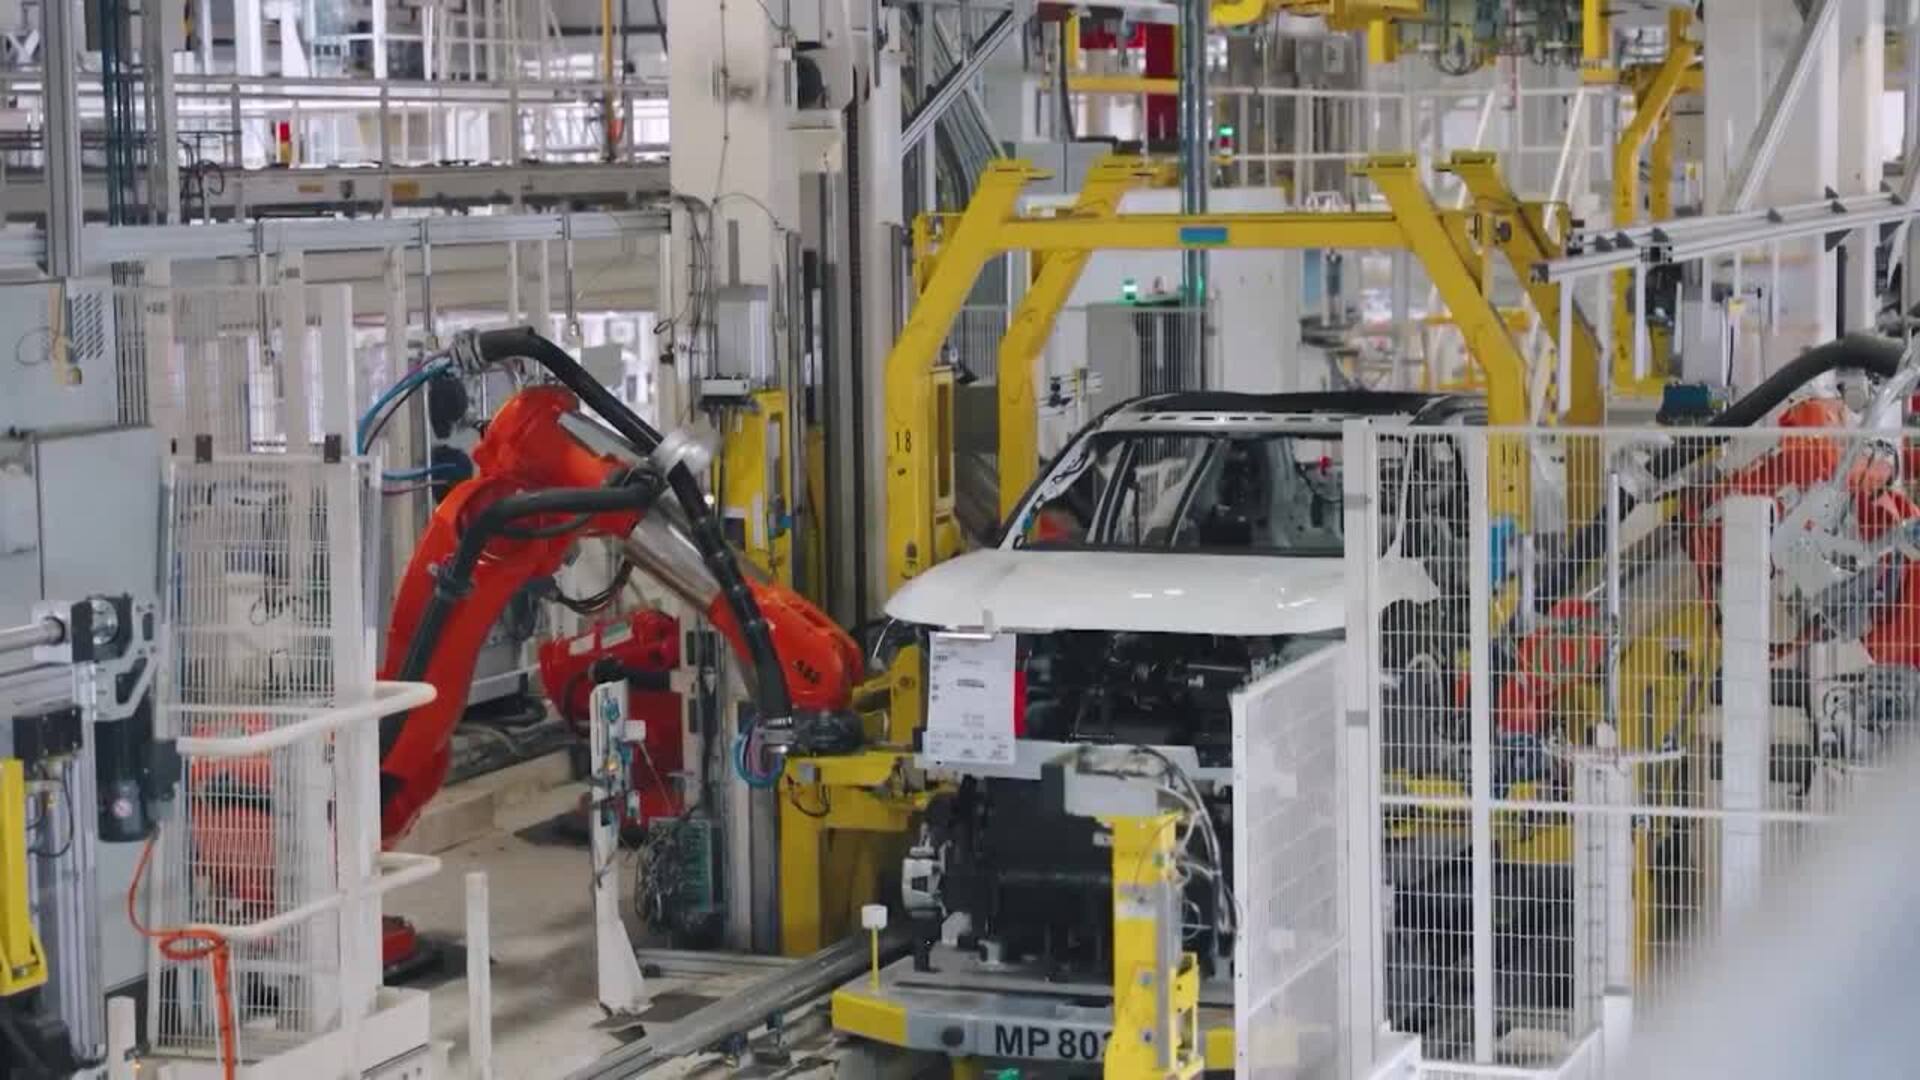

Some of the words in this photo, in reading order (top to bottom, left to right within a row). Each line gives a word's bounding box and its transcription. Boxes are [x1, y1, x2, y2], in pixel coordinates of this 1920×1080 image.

[896, 429, 912, 454] 18
[995, 1023, 1050, 1057] MP
[1057, 1028, 1112, 1060] 80
